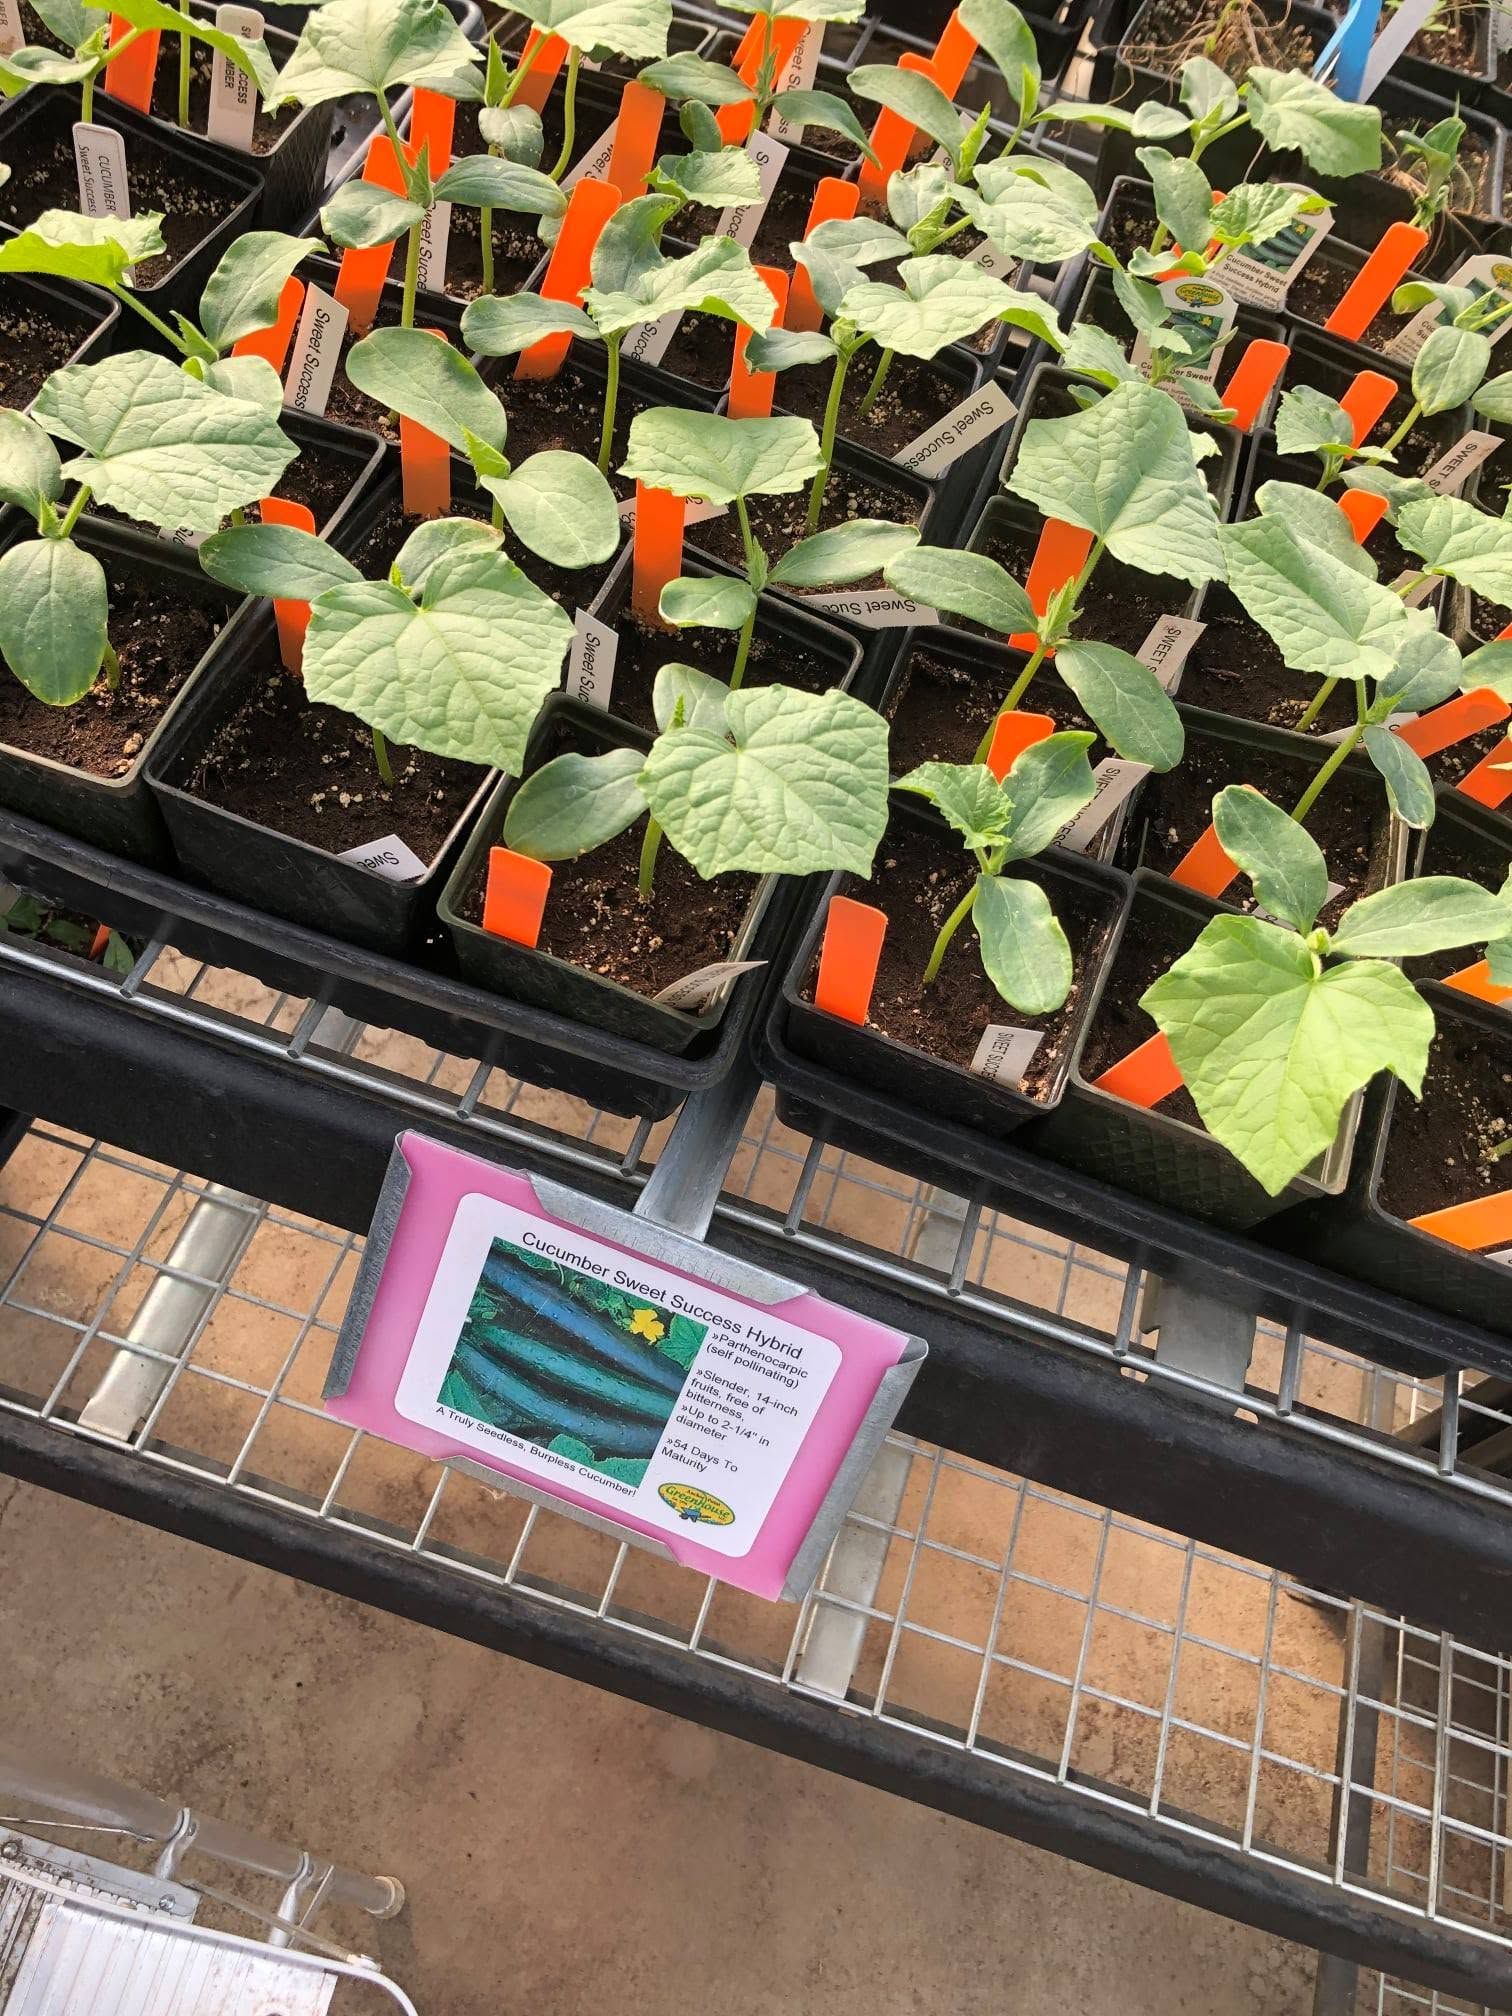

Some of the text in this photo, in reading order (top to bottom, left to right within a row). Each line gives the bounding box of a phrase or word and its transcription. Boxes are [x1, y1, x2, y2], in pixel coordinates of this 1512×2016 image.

[77, 144, 93, 177] Sweet
[97, 155, 117, 212] CUCUMBER
[416, 246, 433, 290] Succe
[1222, 263, 1281, 294] Success Hybrid
[1225, 253, 1288, 288] Cucumber Sweet
[294, 308, 331, 409] Sweet Success
[631, 322, 658, 360] Succe
[903, 400, 995, 472] Sweet Success
[1441, 442, 1478, 480] SWEET
[865, 599, 917, 614] Sweet
[581, 632, 601, 677] Sweet
[1149, 626, 1182, 665] SWEET
[991, 1032, 1015, 1056] SWEET
[521, 1231, 804, 1360] Cucumber Sweet Success Hybrid
[706, 1343, 800, 1390] (self pollinating)
[726, 1392, 750, 1409] free
[752, 1403, 766, 1415] of
[756, 1392, 799, 1417] 14-inch
[675, 1414, 728, 1441] diameter
[707, 1413, 719, 1425] to
[758, 1435, 770, 1447] in
[435, 1406, 639, 1498] A Truly Seedless, Burpless Cucumber!
[661, 1446, 709, 1473] Maturity
[690, 1446, 720, 1465] Days
[723, 1459, 739, 1472] To
